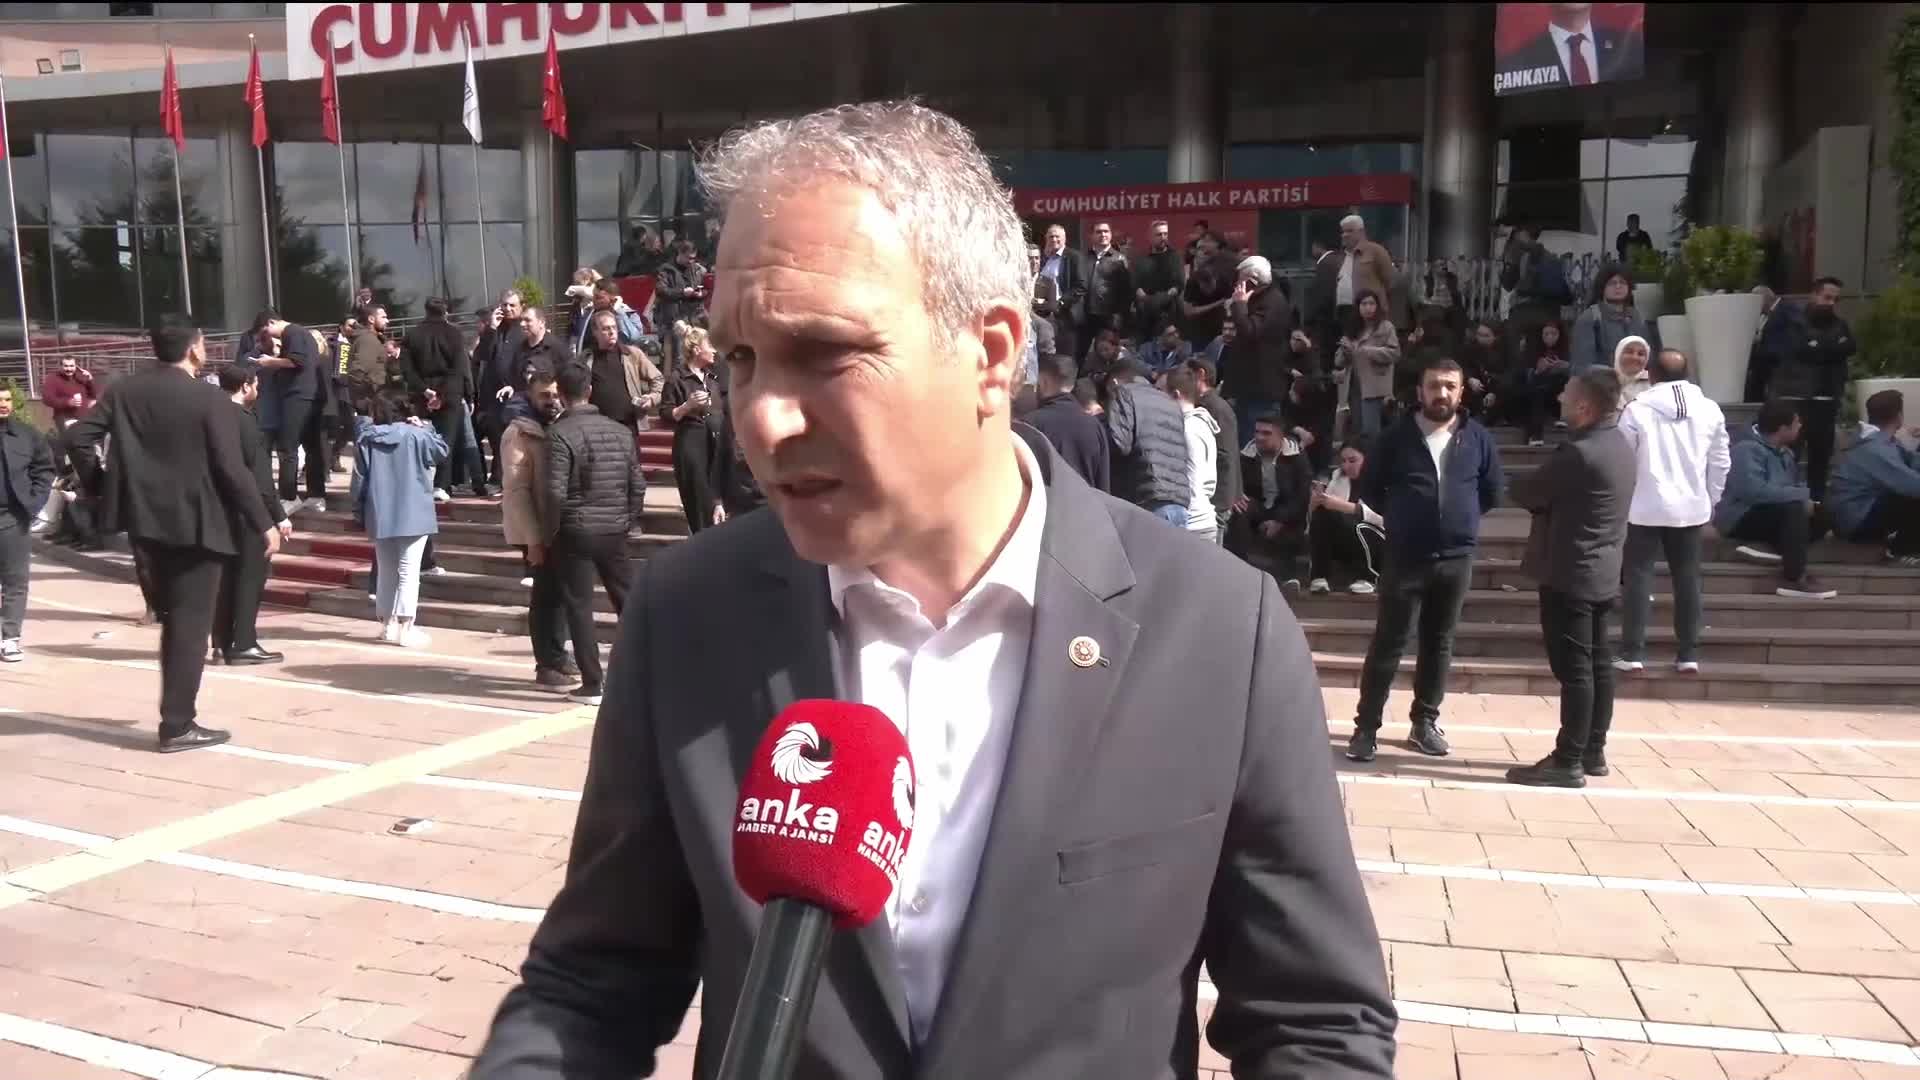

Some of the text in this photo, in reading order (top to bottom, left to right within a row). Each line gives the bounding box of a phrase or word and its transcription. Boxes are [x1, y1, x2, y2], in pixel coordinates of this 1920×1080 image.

[310, 3, 792, 64] CUMHU
[1494, 65, 1560, 93] ÇANKAYA
[1032, 181, 1309, 213] CUMHURİYET HALK PARTİSİ
[737, 822, 776, 835] HABER
[740, 788, 839, 833] anka
[863, 820, 905, 870] ank
